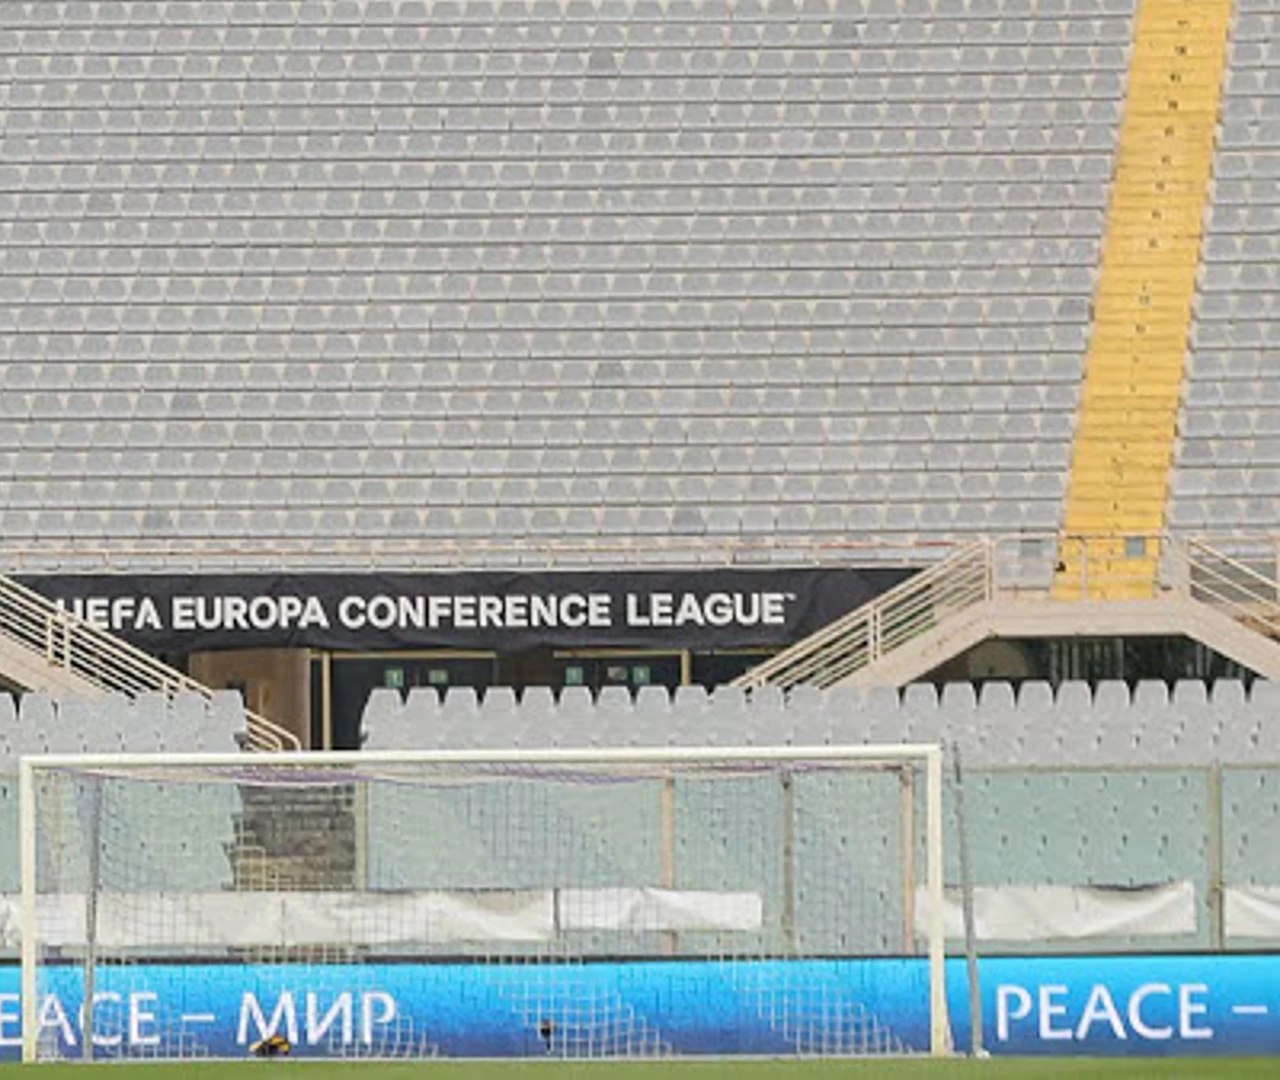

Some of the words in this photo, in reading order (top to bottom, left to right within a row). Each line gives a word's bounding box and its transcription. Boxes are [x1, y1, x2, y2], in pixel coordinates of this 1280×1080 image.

[171, 595, 330, 630] EUROPA
[338, 593, 612, 629] CONFERENCE
[995, 982, 1215, 1041] PEACE
